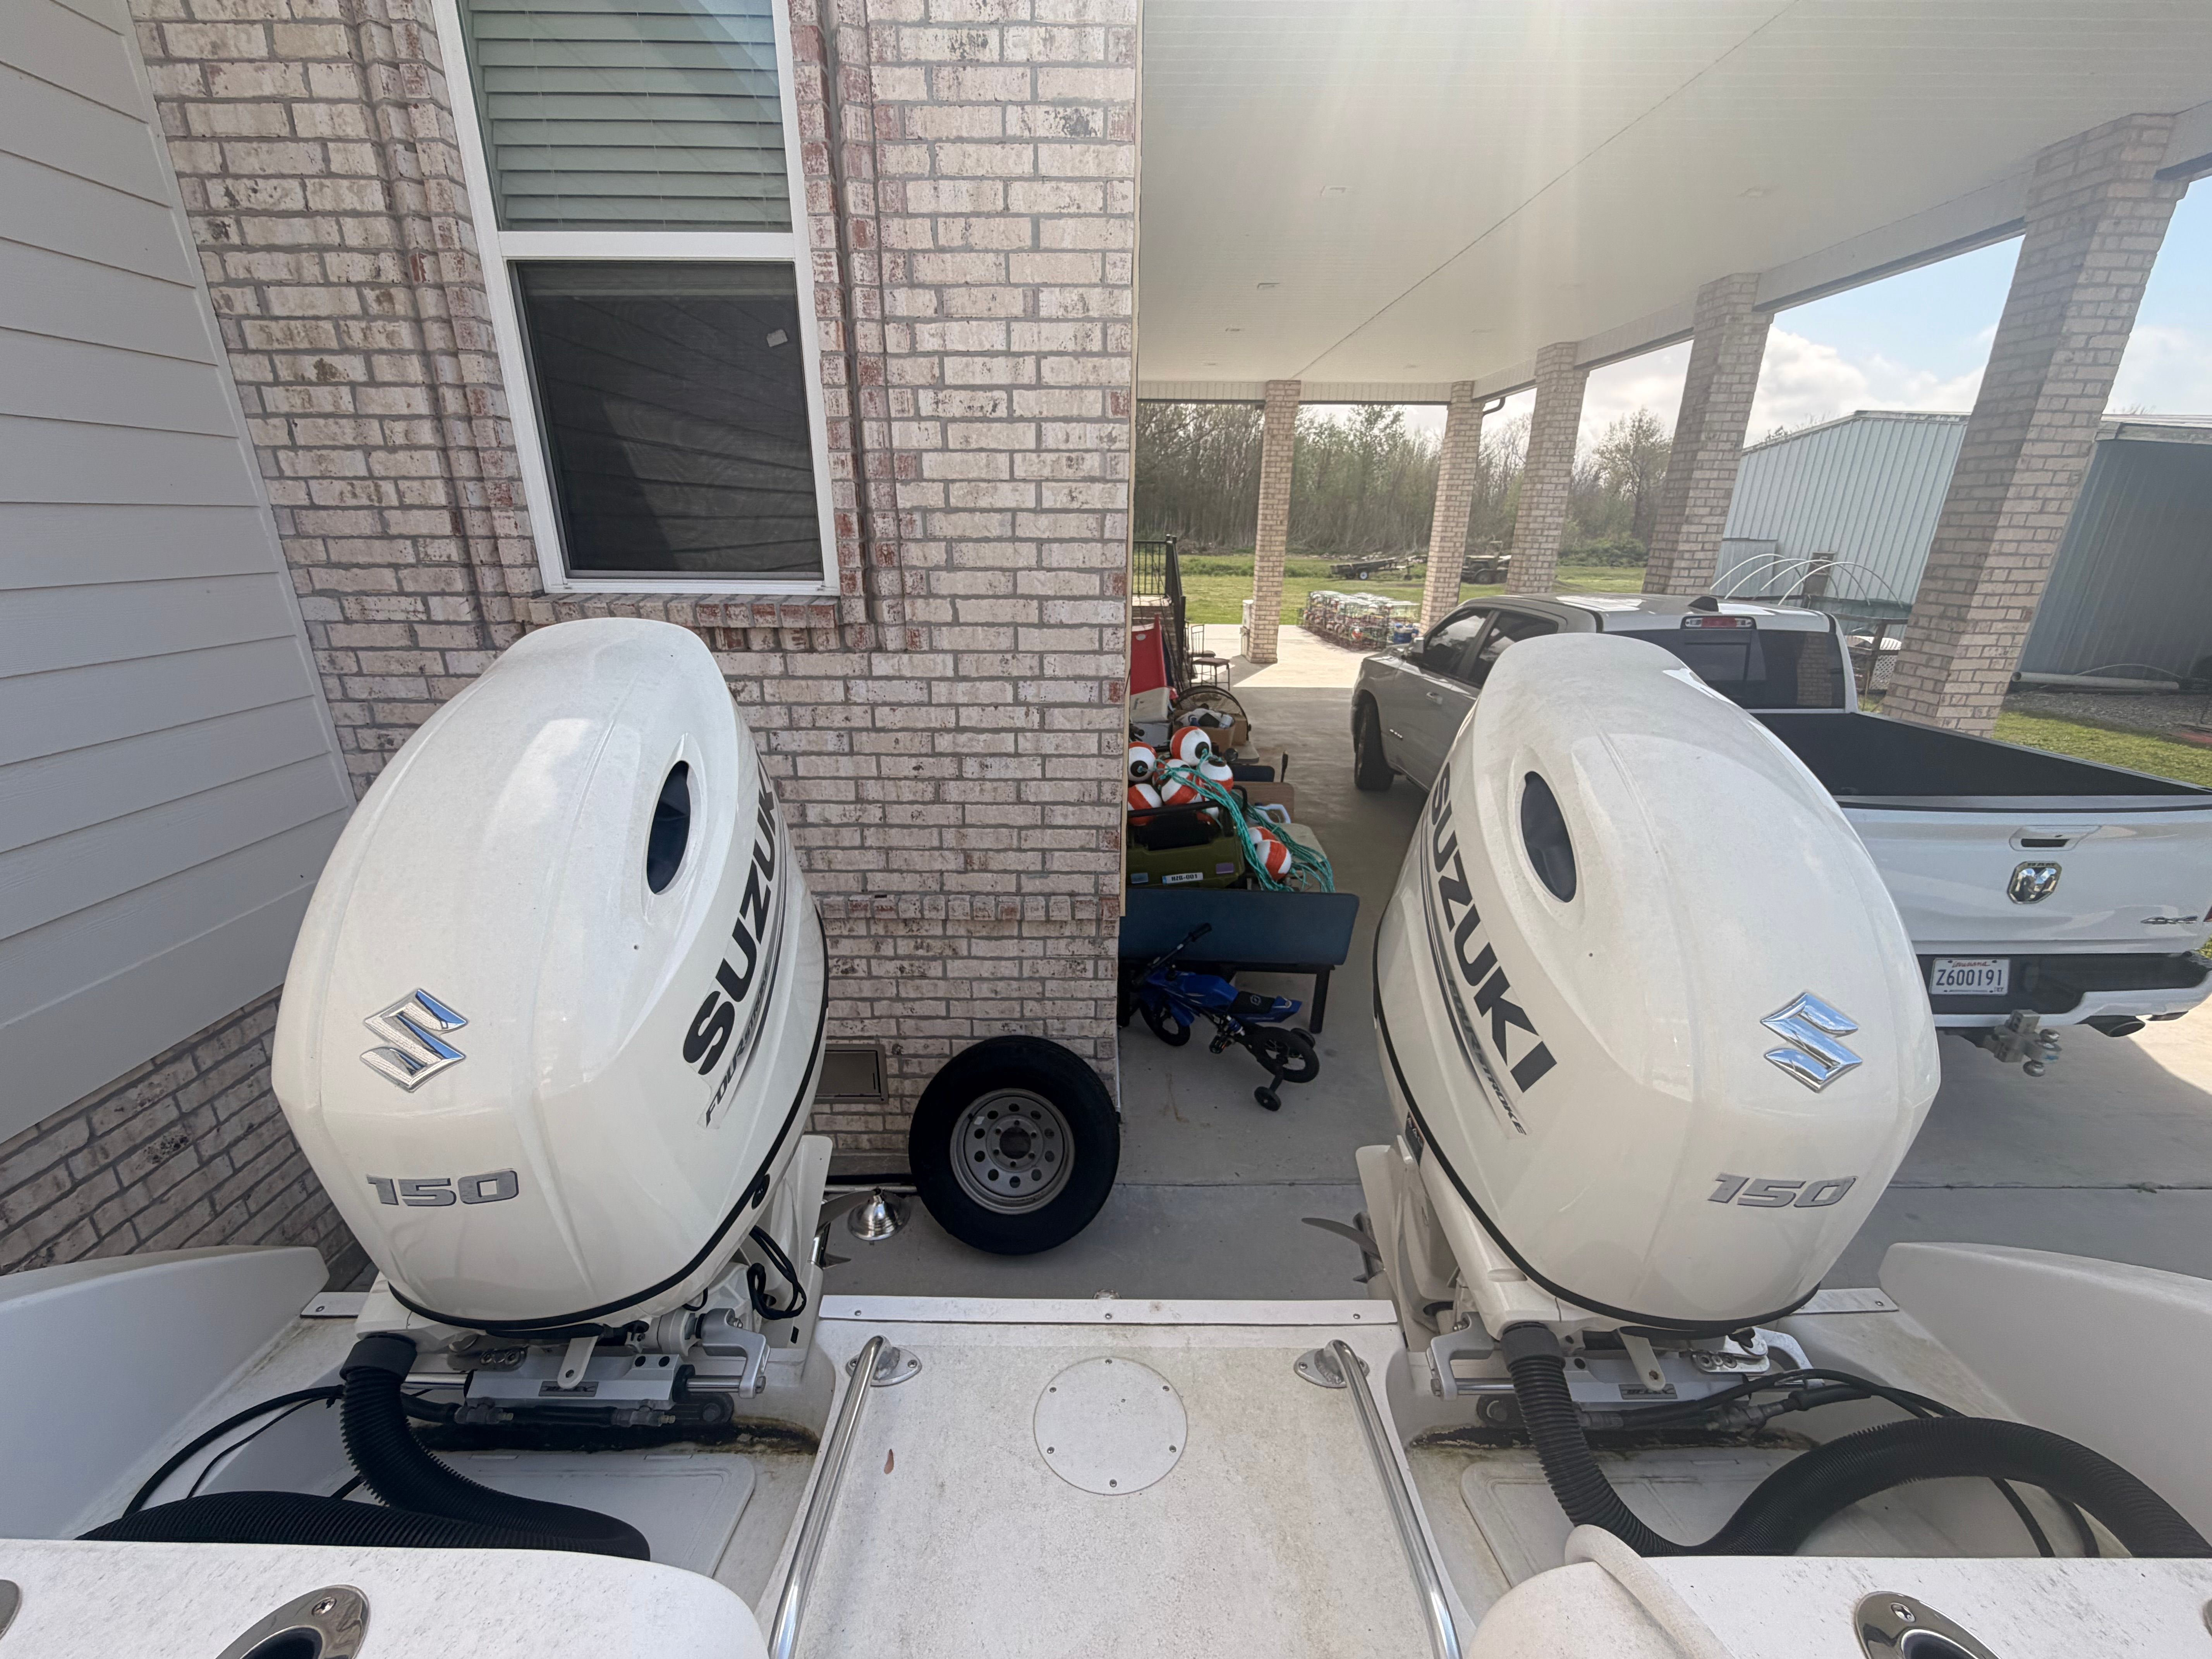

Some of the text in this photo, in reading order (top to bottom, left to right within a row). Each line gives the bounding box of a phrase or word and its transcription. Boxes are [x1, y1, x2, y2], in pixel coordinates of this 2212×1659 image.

[1432, 762, 1558, 1093] SUZUKI
[1936, 969, 2002, 986] Z600191
[366, 1168, 519, 1207] 150
[1707, 1173, 1858, 1208] 150
